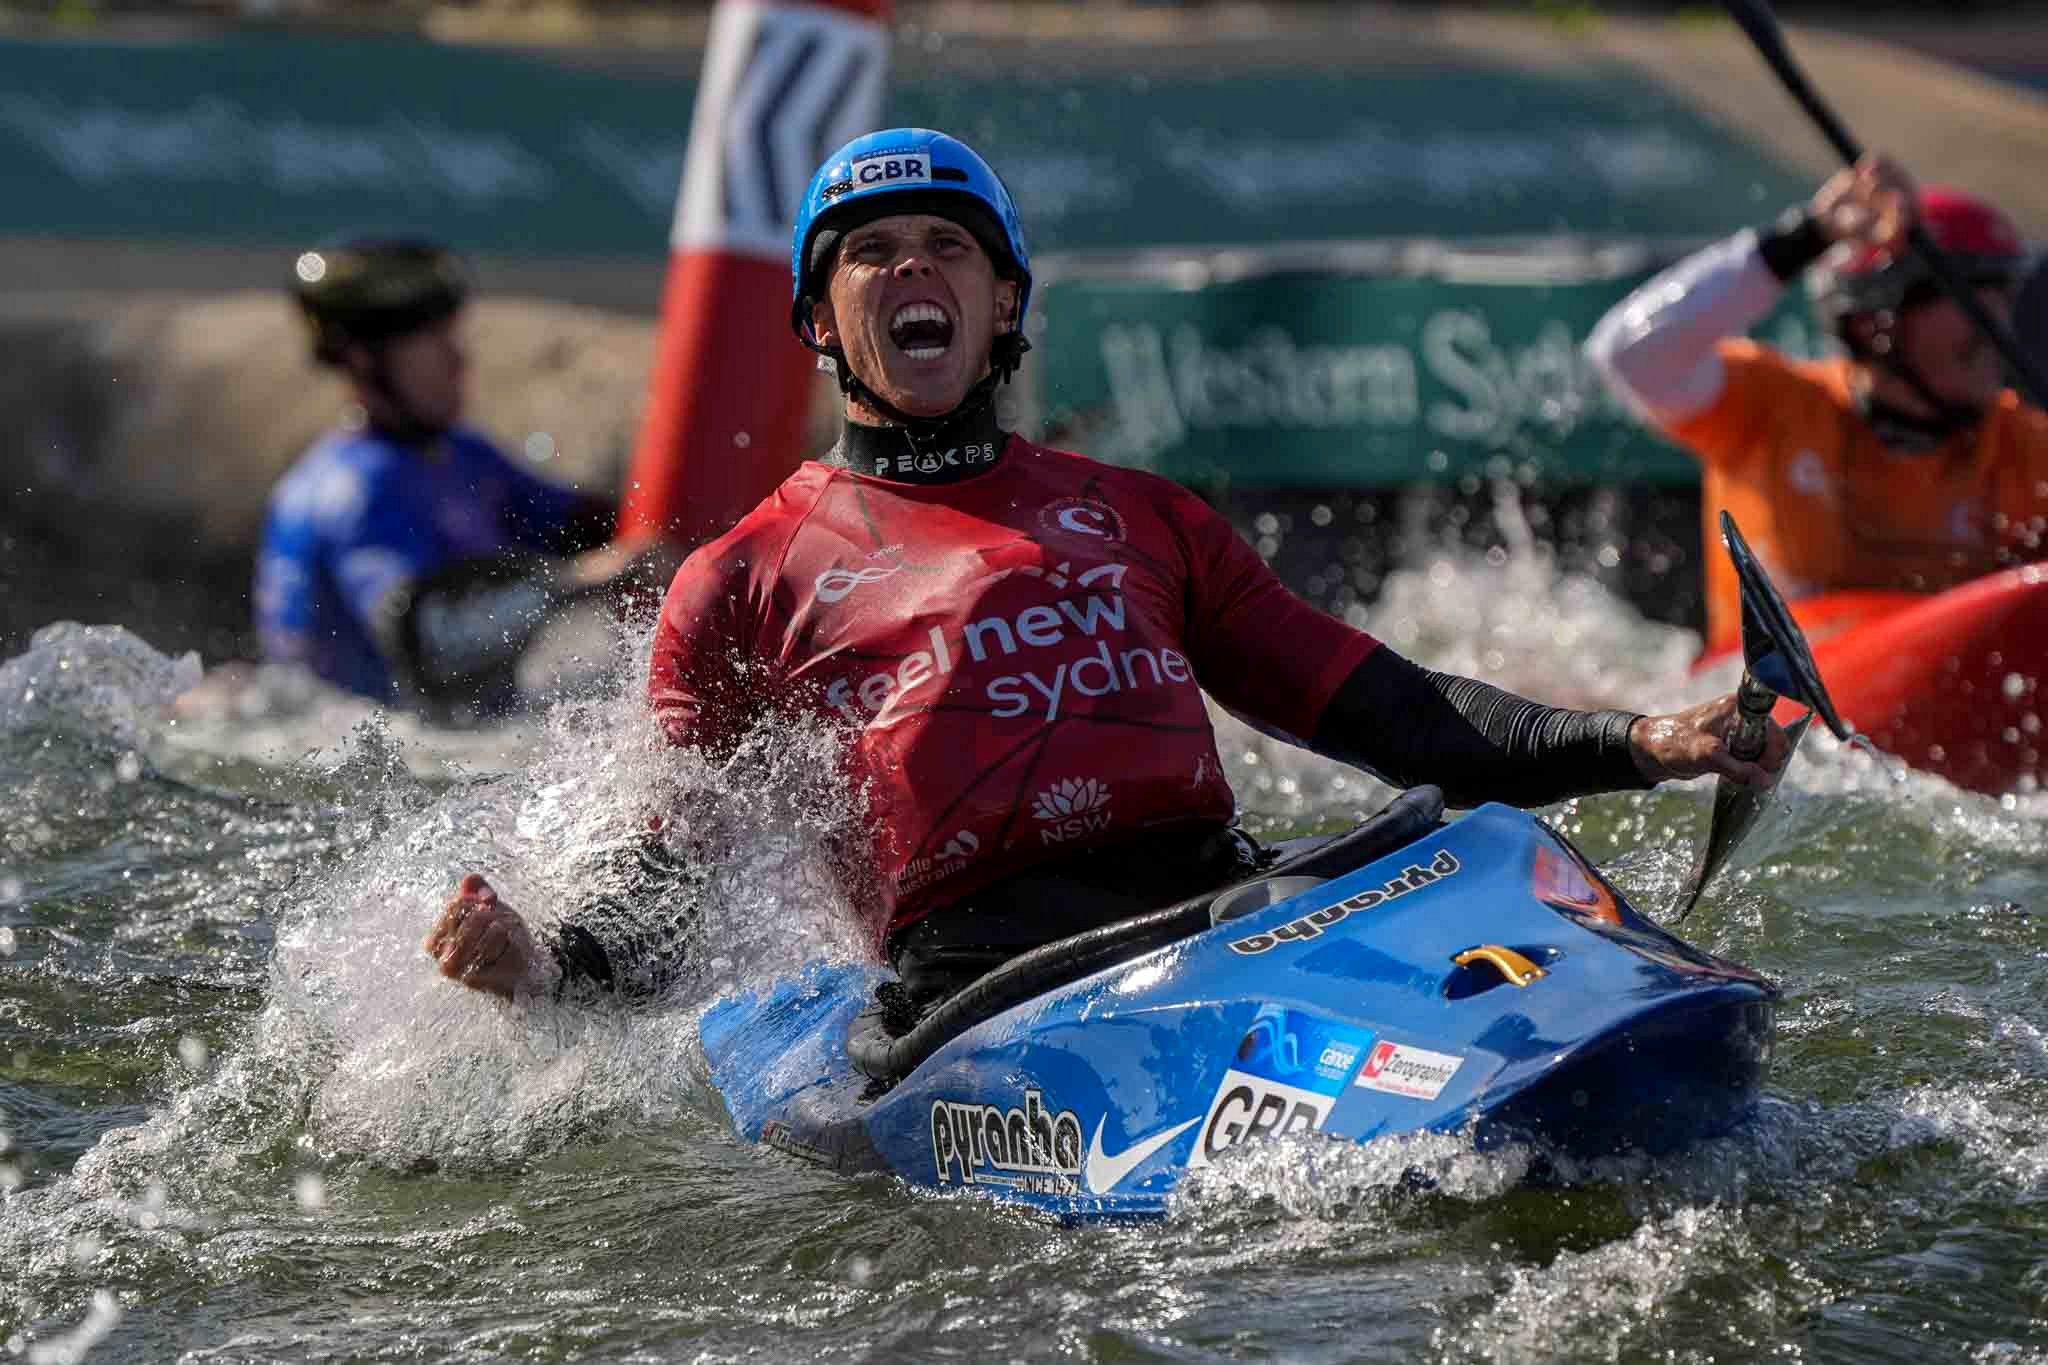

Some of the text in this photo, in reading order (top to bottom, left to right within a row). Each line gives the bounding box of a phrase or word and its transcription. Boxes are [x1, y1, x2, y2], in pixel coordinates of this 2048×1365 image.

[859, 159, 924, 184] GBR
[825, 593, 1129, 724] feel new
[985, 641, 1193, 723] sydne
[1041, 810, 1112, 846] NSW
[1228, 849, 1460, 955] pyranha
[931, 1088, 1082, 1185] pyranha
